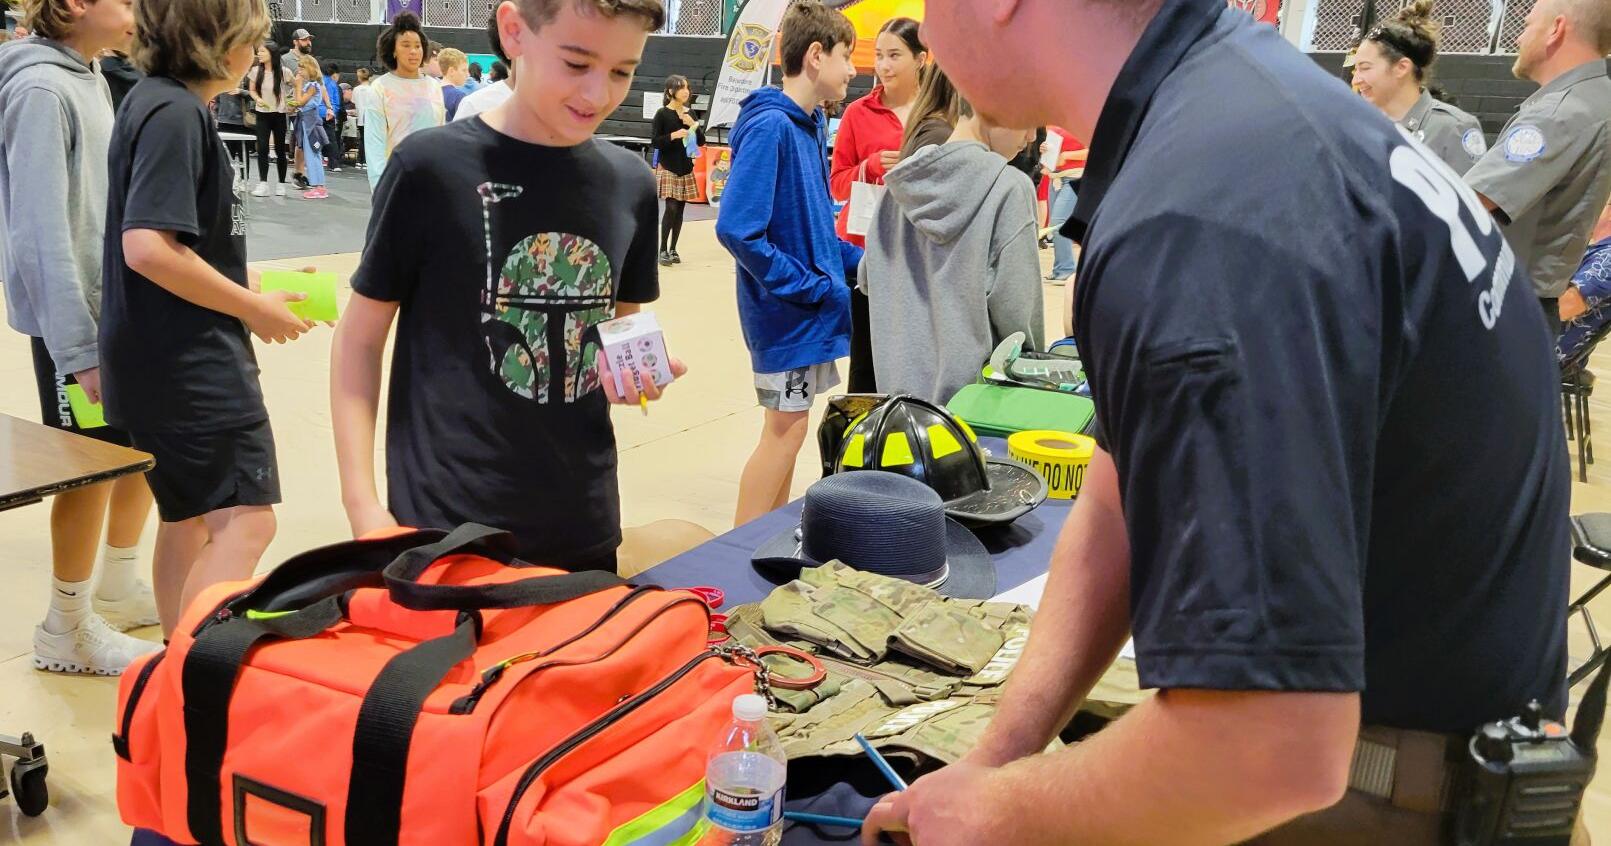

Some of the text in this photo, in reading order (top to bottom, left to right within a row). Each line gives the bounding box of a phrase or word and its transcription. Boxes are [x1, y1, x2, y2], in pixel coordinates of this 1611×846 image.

[621, 342, 633, 361] Ball
[55, 373, 72, 427] MOUR
[1043, 463, 1061, 491] DO
[715, 791, 758, 807] KIRKLAND
